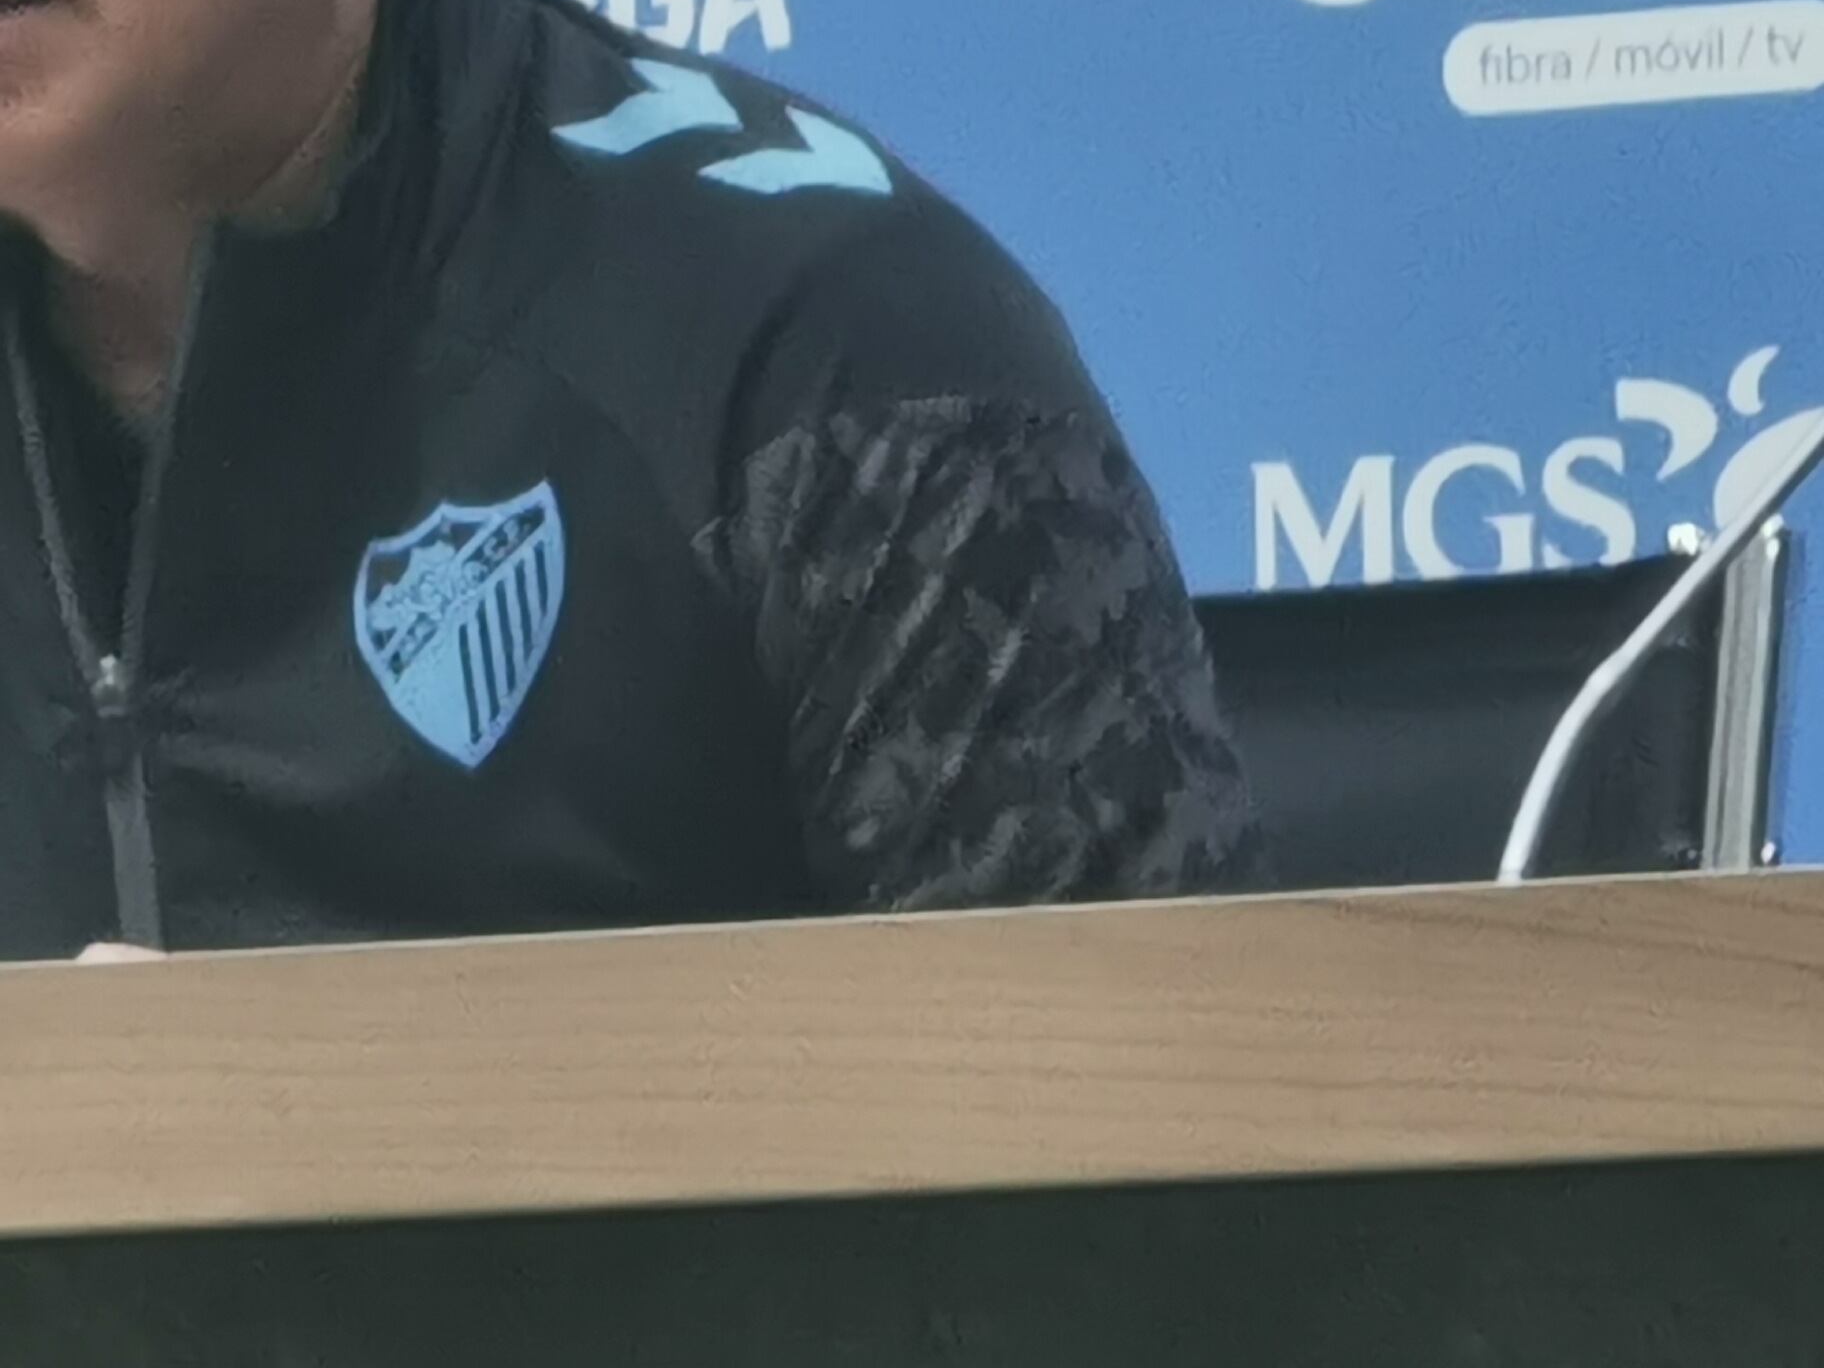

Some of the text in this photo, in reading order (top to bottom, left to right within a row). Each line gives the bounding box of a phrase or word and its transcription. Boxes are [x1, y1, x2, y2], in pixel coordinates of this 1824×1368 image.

[1479, 42, 1573, 85] fibra
[1614, 28, 1725, 78] móvil
[1766, 24, 1806, 67] tv
[1250, 435, 1637, 592] MGS
